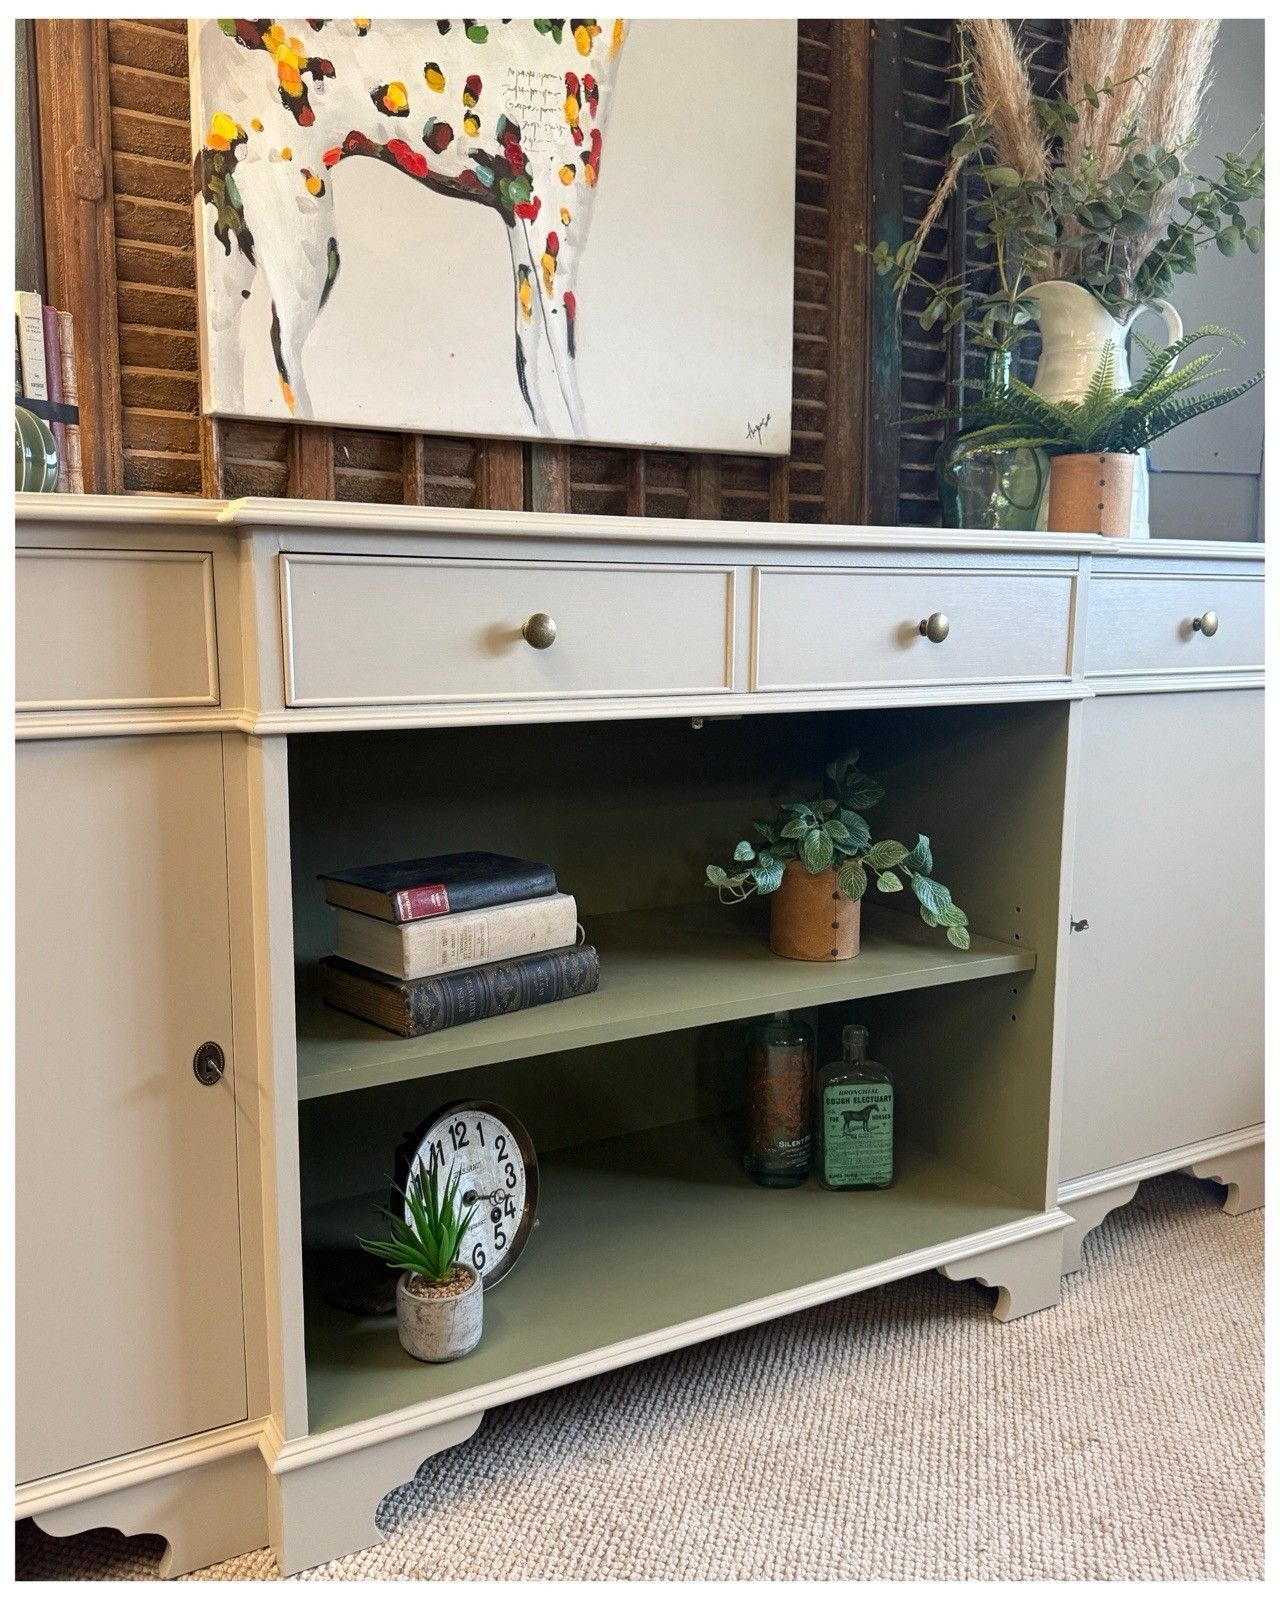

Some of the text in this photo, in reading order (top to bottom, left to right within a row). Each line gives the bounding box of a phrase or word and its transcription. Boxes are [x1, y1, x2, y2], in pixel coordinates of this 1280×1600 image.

[826, 1095, 892, 1105] COUGH ELECTUARY
[449, 1121, 469, 1150] 12
[476, 1121, 485, 1147] 1
[495, 1135, 509, 1163] 2
[504, 1162, 517, 1188] 3
[504, 1194, 517, 1219] 4
[494, 1223, 507, 1250] 5
[472, 1243, 486, 1270] 6
